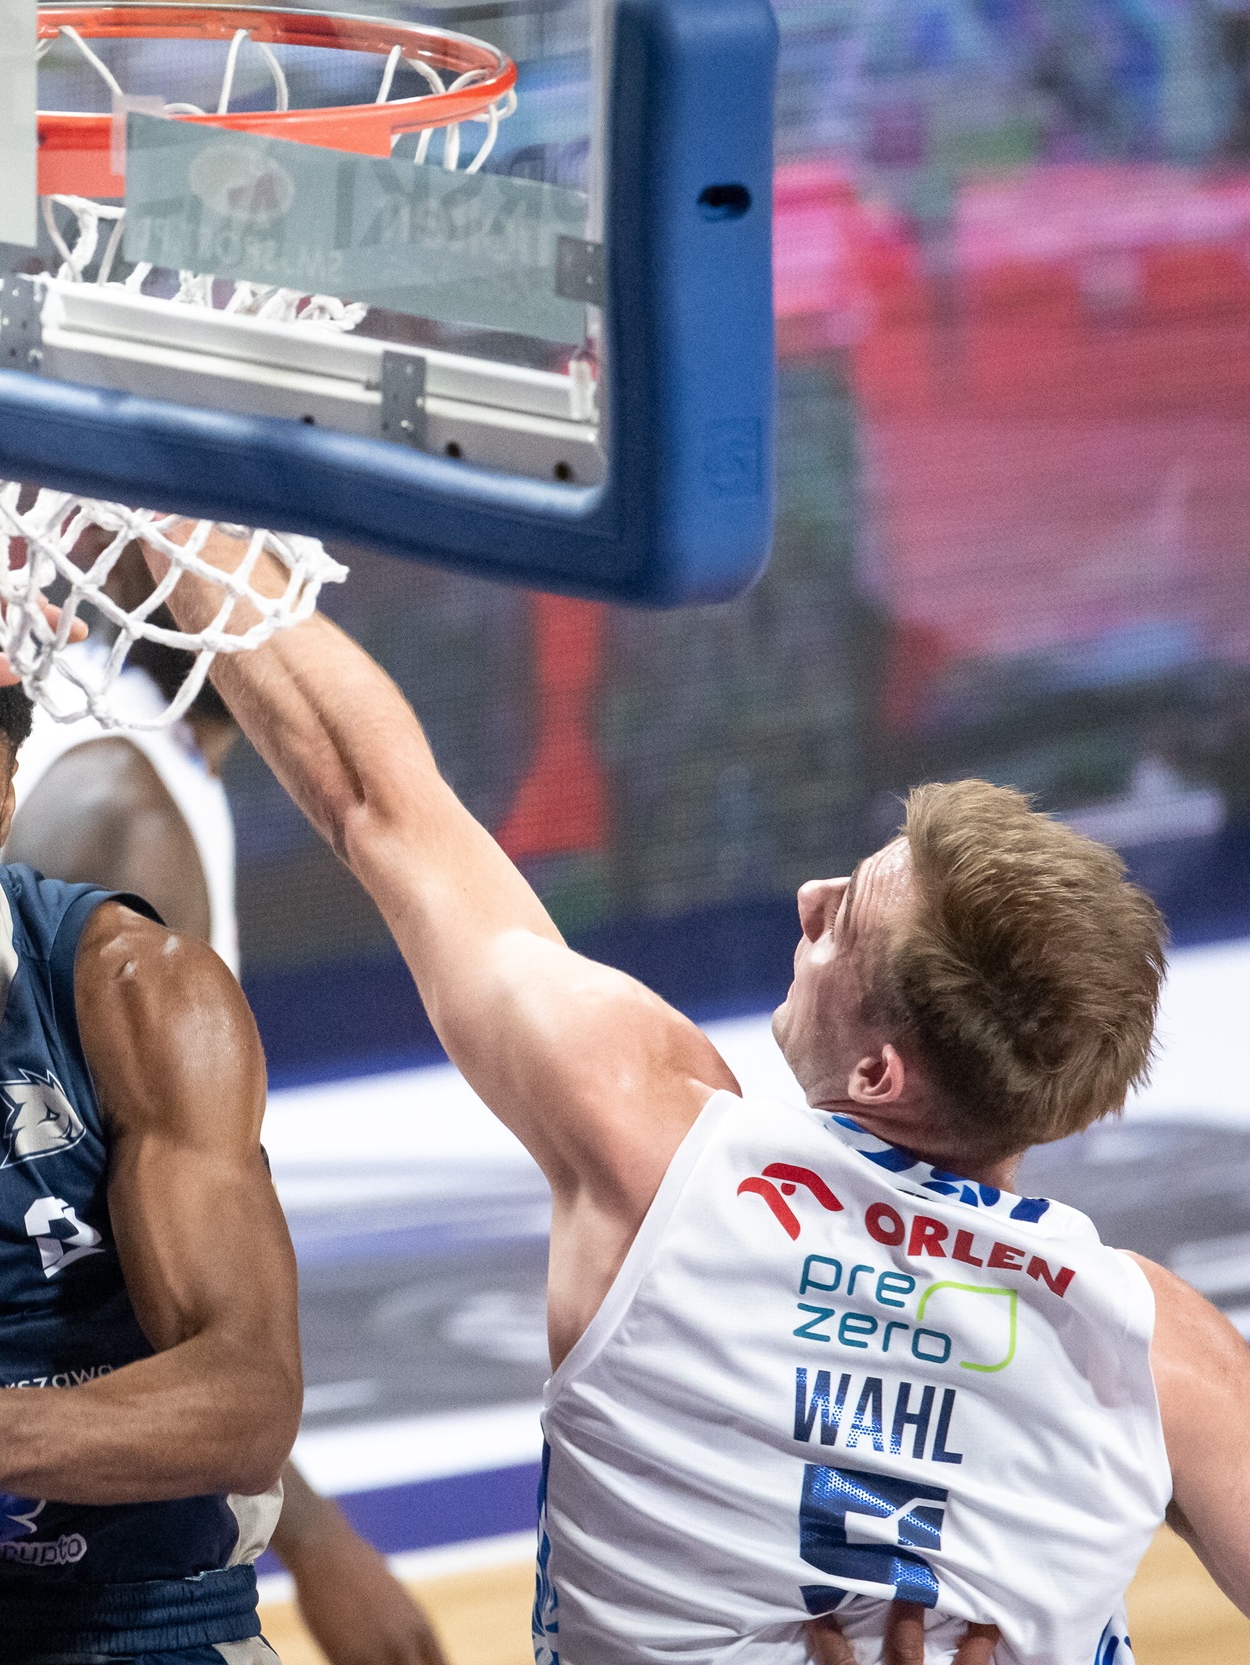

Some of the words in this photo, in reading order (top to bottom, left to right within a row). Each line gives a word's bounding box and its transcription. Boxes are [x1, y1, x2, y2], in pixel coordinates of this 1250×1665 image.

[799, 1254, 916, 1308] pre
[864, 1202, 1076, 1298] ORLEN
[793, 1302, 952, 1364] zero
[793, 1367, 963, 1464] WAHL
[799, 1463, 949, 1616] 5
